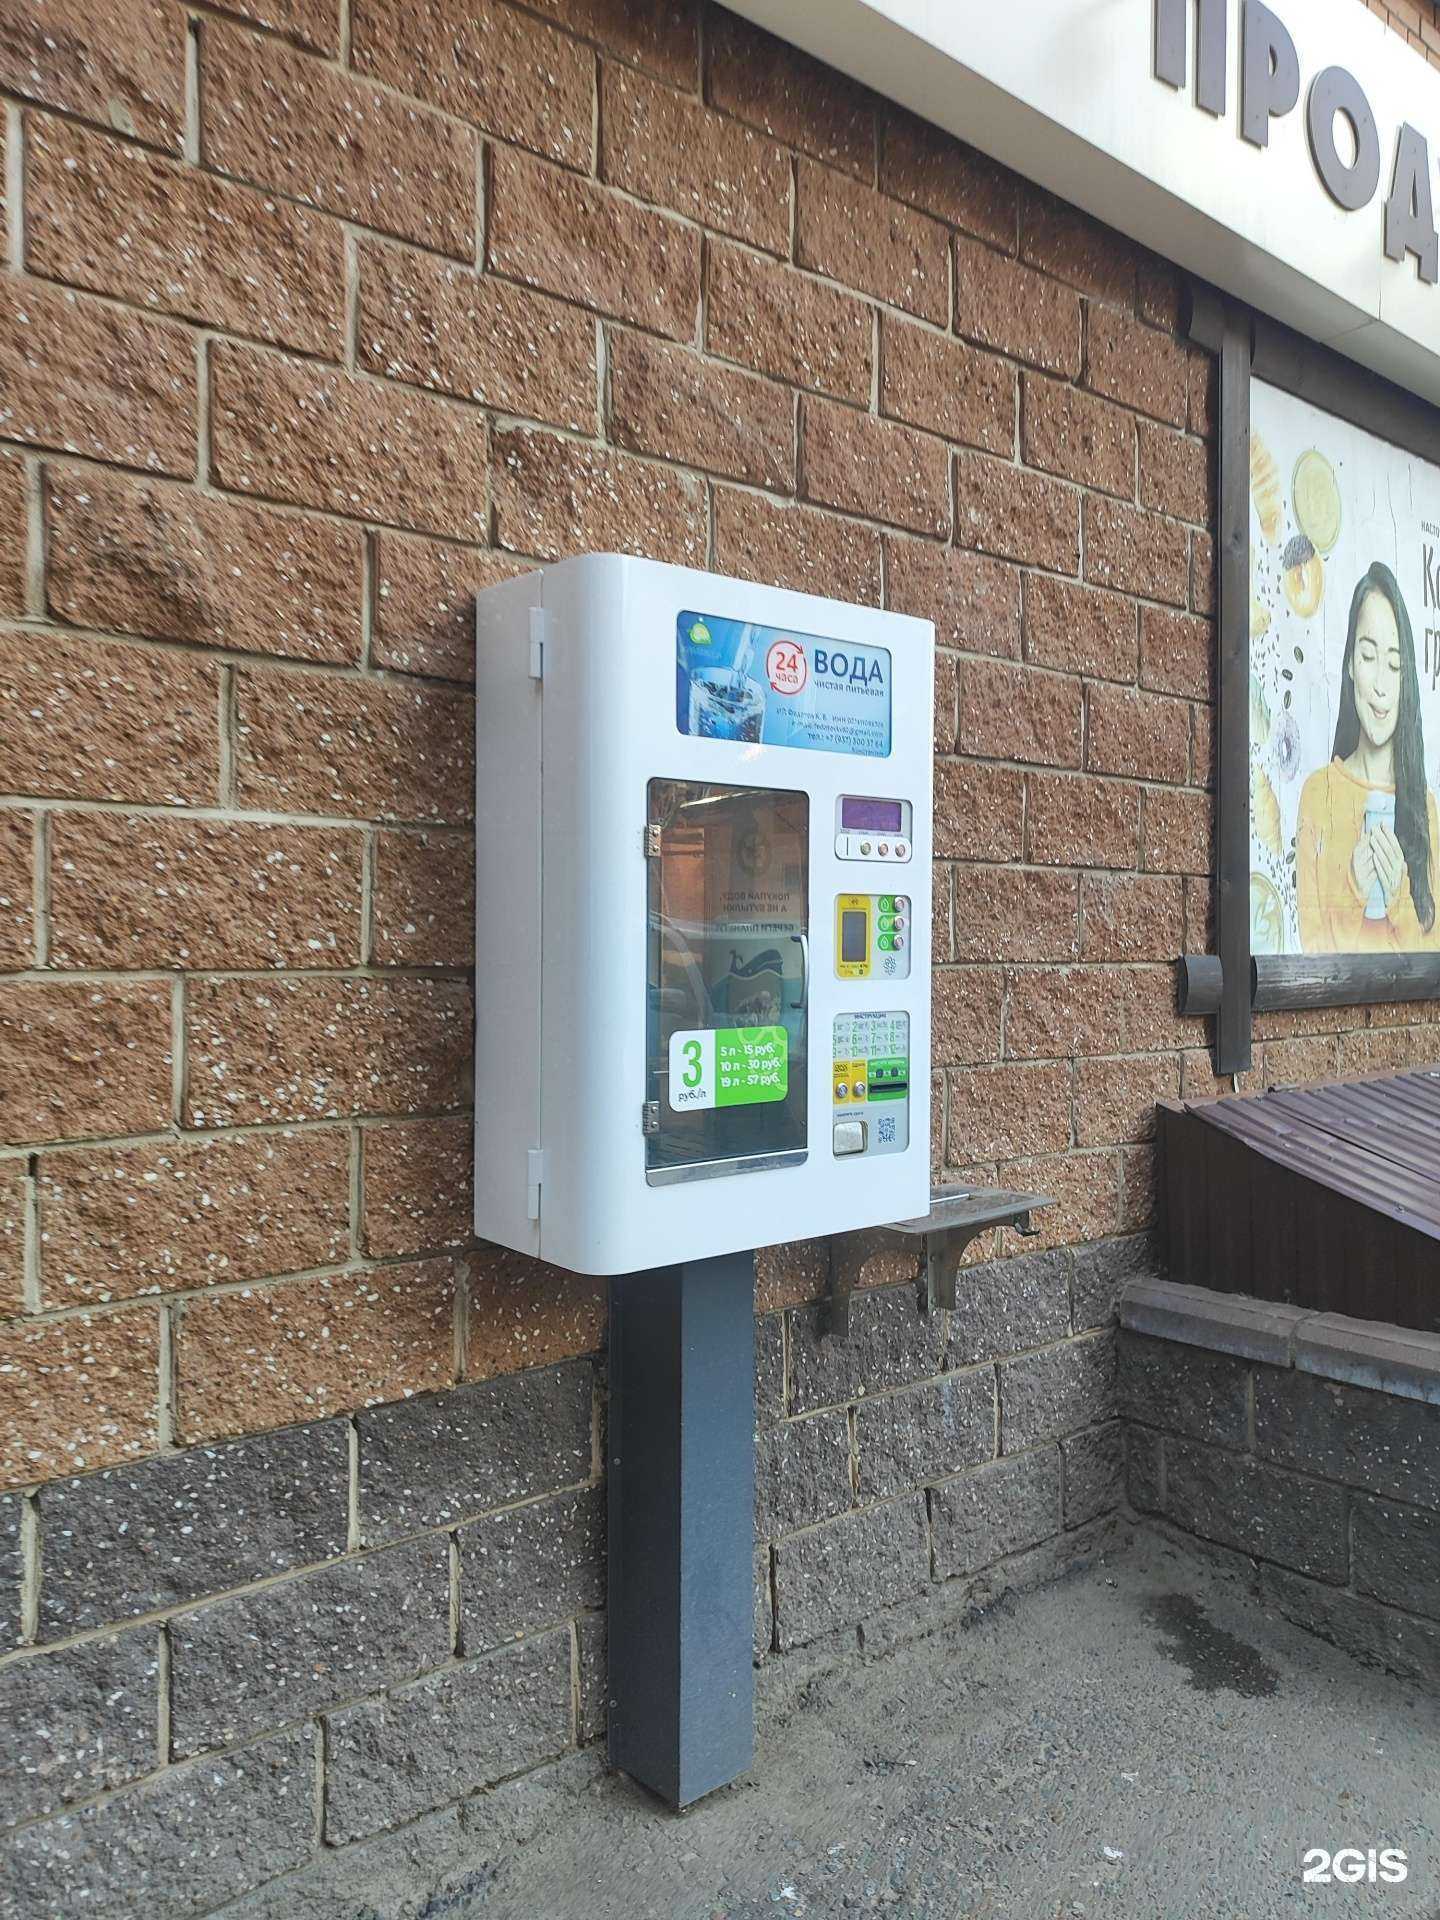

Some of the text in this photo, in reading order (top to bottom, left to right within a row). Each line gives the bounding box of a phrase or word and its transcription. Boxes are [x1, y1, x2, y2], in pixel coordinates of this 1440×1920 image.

[776, 651, 798, 673] 24
[814, 649, 884, 688] ВОДА
[775, 673, 799, 685] часа
[814, 681, 884, 697] чистая питьевая
[720, 1047, 727, 1056] 5
[728, 1047, 736, 1056] л
[743, 1044, 753, 1055] 15
[754, 1042, 776, 1056] руб.
[682, 1040, 702, 1088] 3
[720, 1062, 731, 1072] 10
[732, 1062, 740, 1071] л
[747, 1059, 760, 1070] 30
[761, 1057, 782, 1070] руб.
[732, 1077, 740, 1086] л
[747, 1074, 759, 1086] 57
[678, 1088, 707, 1103] руб./л
